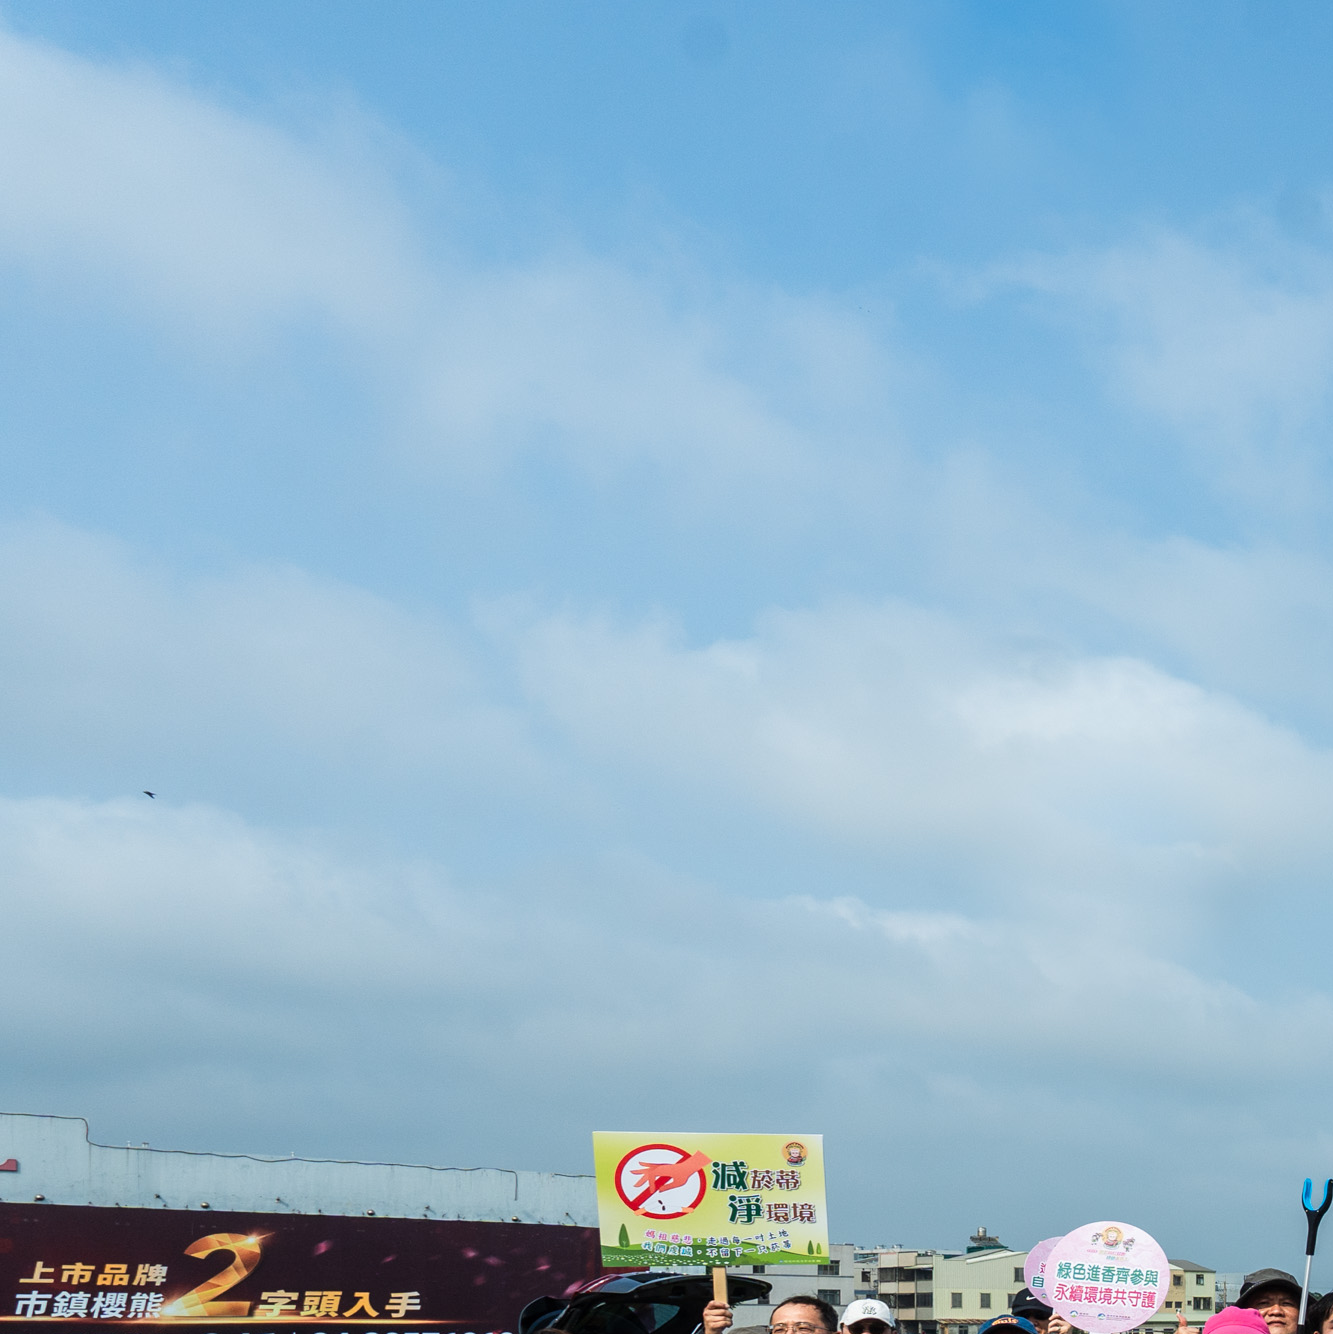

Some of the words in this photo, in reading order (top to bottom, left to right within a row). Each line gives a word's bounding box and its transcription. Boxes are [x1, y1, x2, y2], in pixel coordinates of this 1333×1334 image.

[711, 1160, 801, 1191] 減菸蒂
[728, 1194, 817, 1224] 淨環境
[18, 1261, 168, 1287] 上市品牌
[1056, 1261, 1159, 1287] 綠色進香齊參與
[258, 1289, 422, 1318] 字頭入手
[1054, 1283, 1157, 1309] 永續環境共守護
